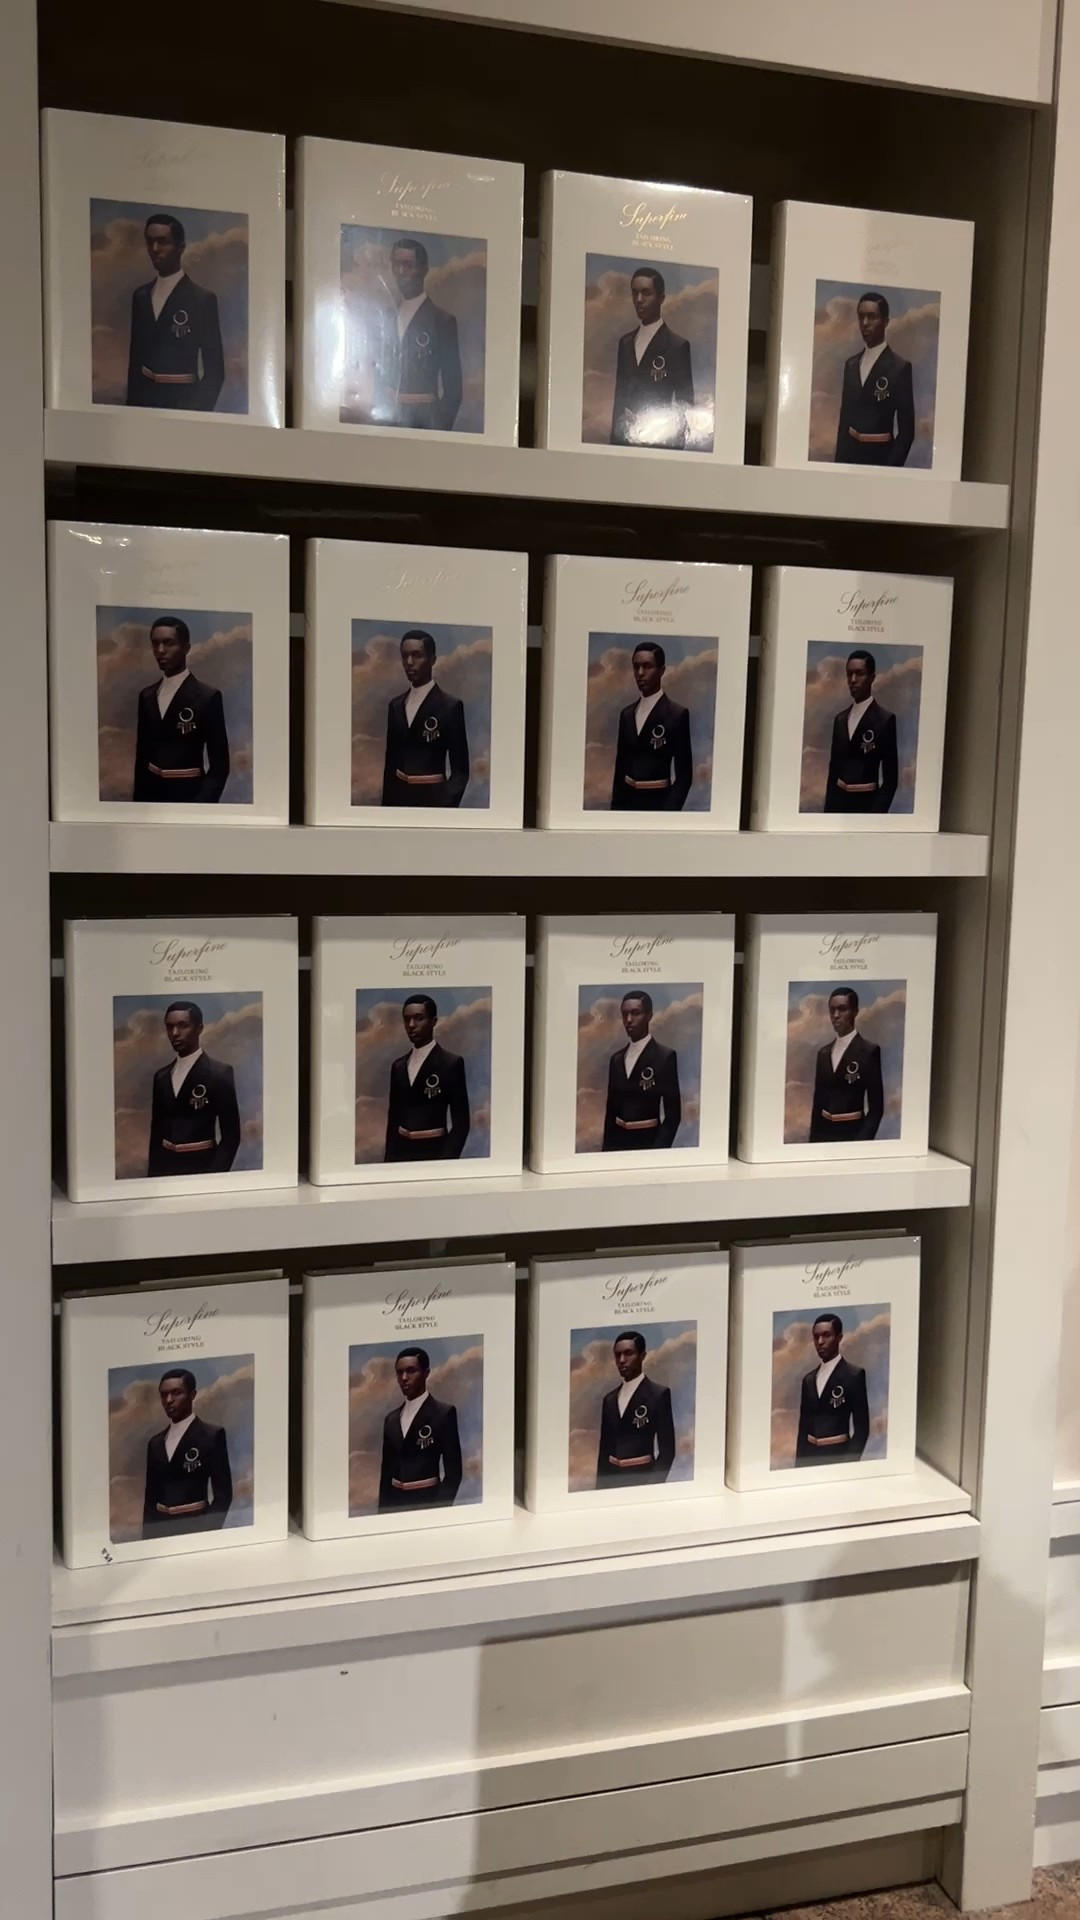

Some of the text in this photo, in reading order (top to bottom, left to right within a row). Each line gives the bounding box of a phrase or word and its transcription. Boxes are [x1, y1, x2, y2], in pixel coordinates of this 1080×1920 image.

[619, 201, 688, 232] Superfine
[621, 577, 690, 607] Superfine
[837, 588, 899, 617] Superfine
[149, 935, 227, 968] Superfine
[389, 931, 461, 963] Superfine
[610, 930, 674, 960] Superfine
[819, 930, 881, 958] Superfine
[802, 1254, 865, 1285] Superfine
[382, 1282, 453, 1316] Superfine
[602, 1270, 668, 1301] Superfine
[143, 1302, 220, 1337] Superfine
[158, 1341, 204, 1352] BLACK STYLE
[161, 1336, 201, 1344] TAILORING
